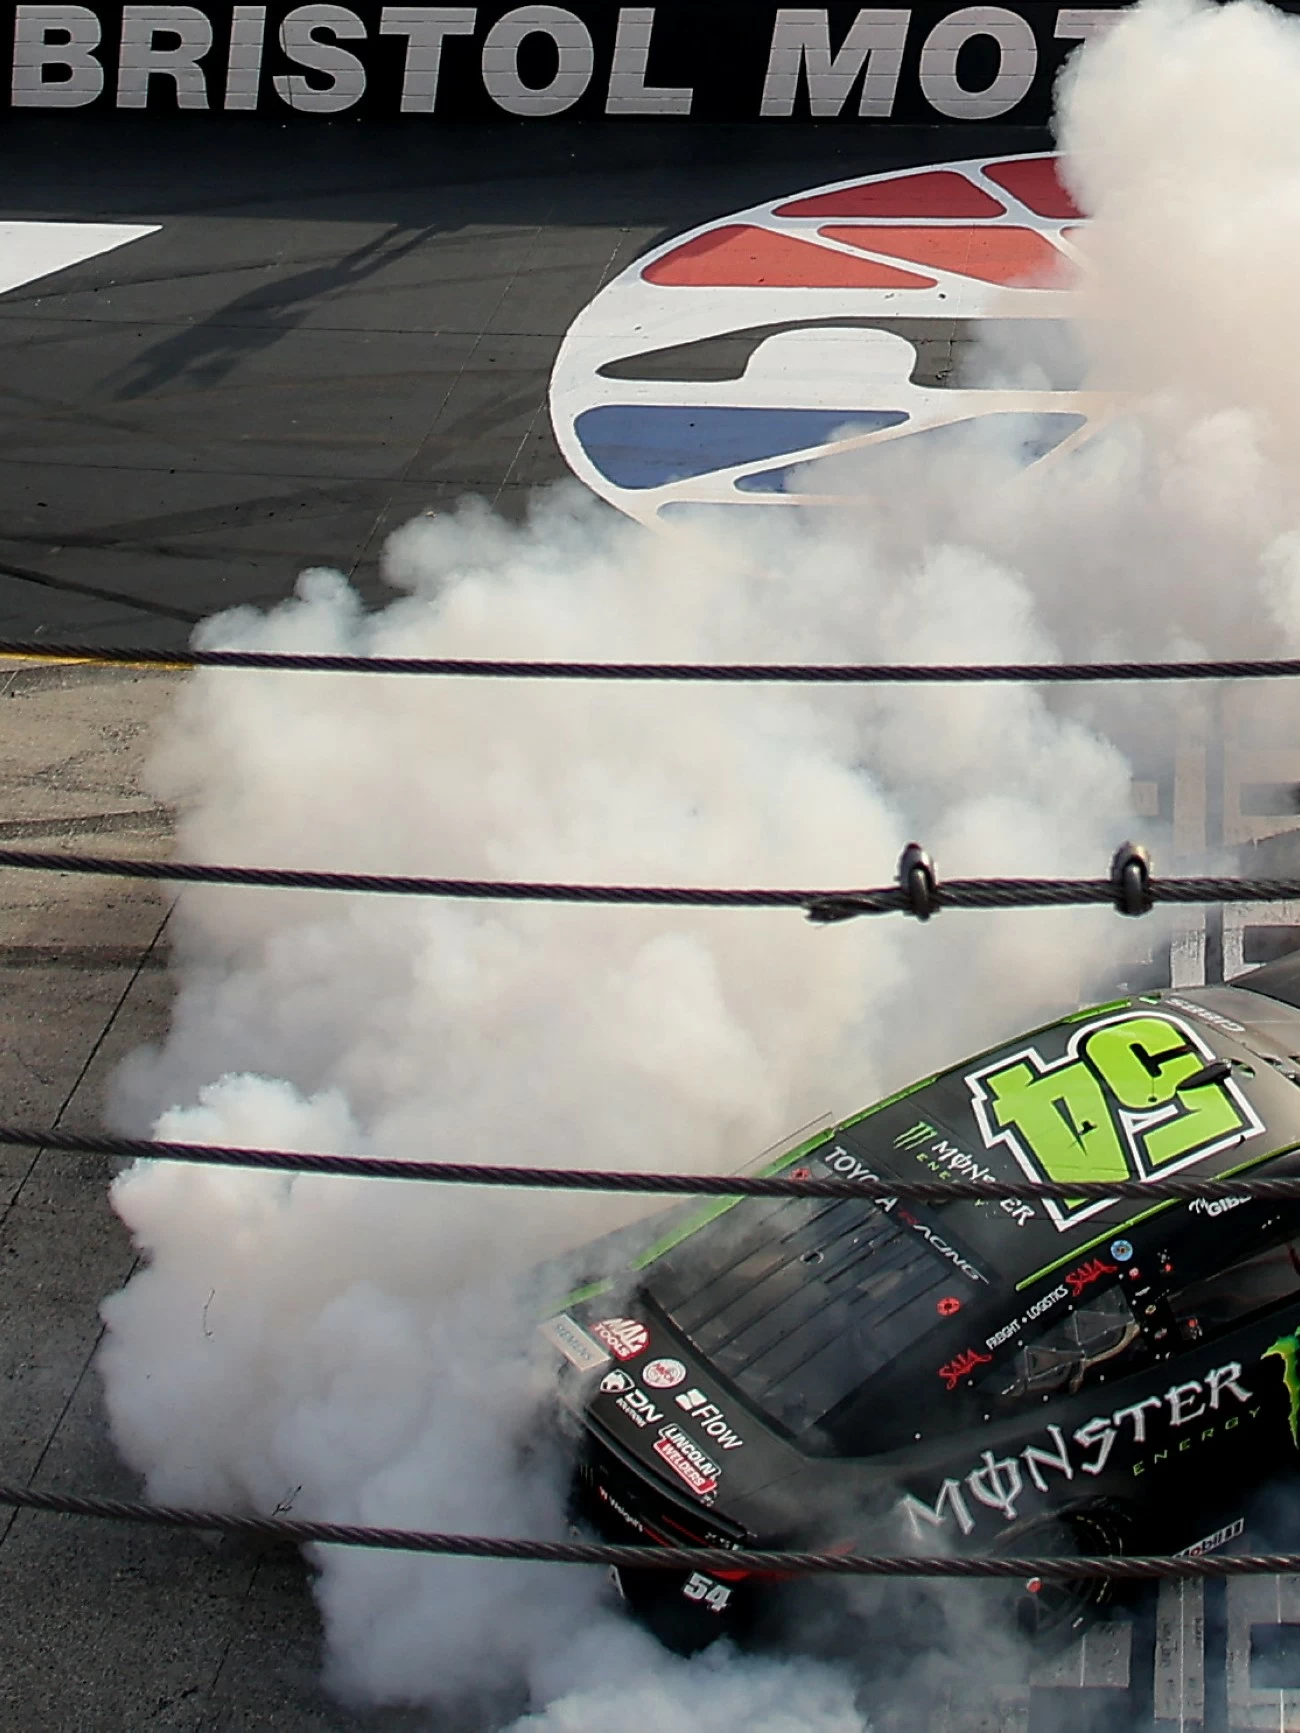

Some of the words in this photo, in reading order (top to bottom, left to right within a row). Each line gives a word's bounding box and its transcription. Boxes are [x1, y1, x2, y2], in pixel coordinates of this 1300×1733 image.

[11, 3, 695, 118] BRISTOL
[965, 1011, 1265, 1232] 54
[593, 1323, 632, 1358] TOOLS
[600, 1317, 649, 1354] MAC
[985, 1319, 1021, 1351] FREIGHT
[1026, 1283, 1069, 1321] LOGISTICS
[661, 1443, 706, 1487] WELDERS
[664, 1426, 717, 1476] LINCOLN
[1132, 1406, 1261, 1477] ENERGY
[683, 1571, 732, 1612] 54
